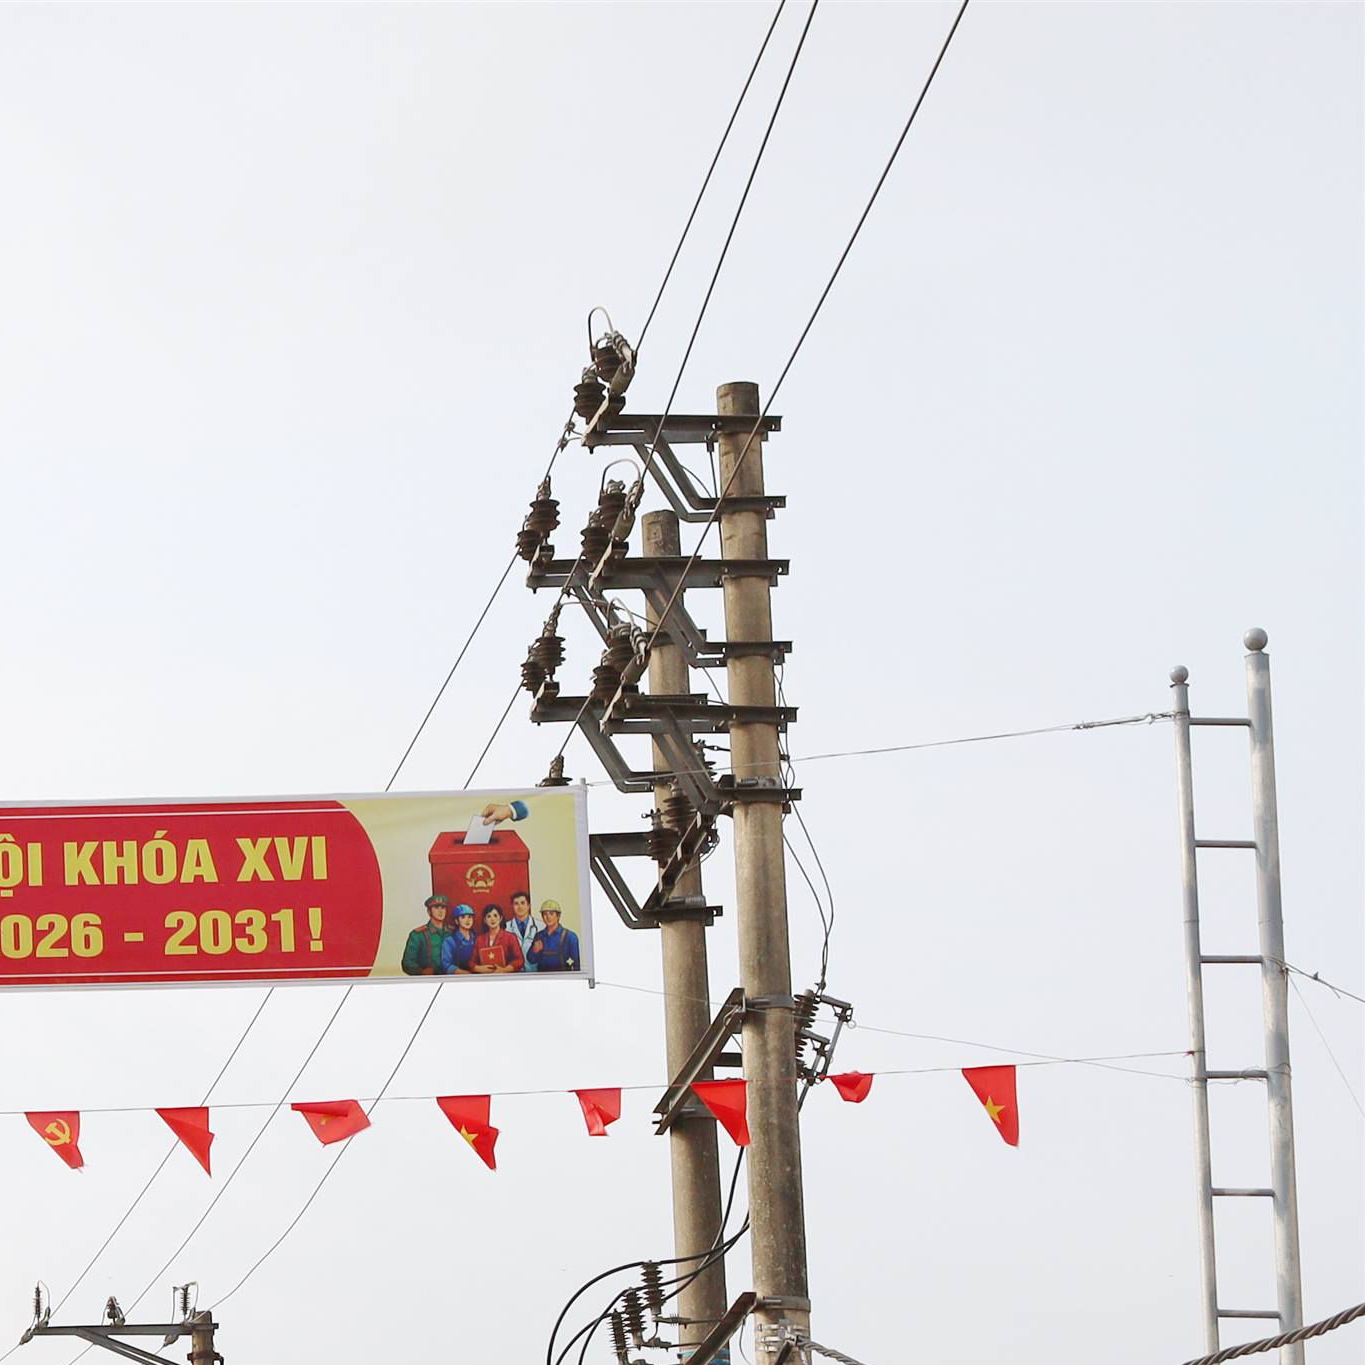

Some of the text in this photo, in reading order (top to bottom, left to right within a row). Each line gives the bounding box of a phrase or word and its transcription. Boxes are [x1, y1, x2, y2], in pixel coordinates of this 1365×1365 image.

[63, 830, 219, 886] KHÓA
[235, 836, 329, 882] XVI
[123, 933, 145, 943] -
[163, 907, 325, 957] 2031!
